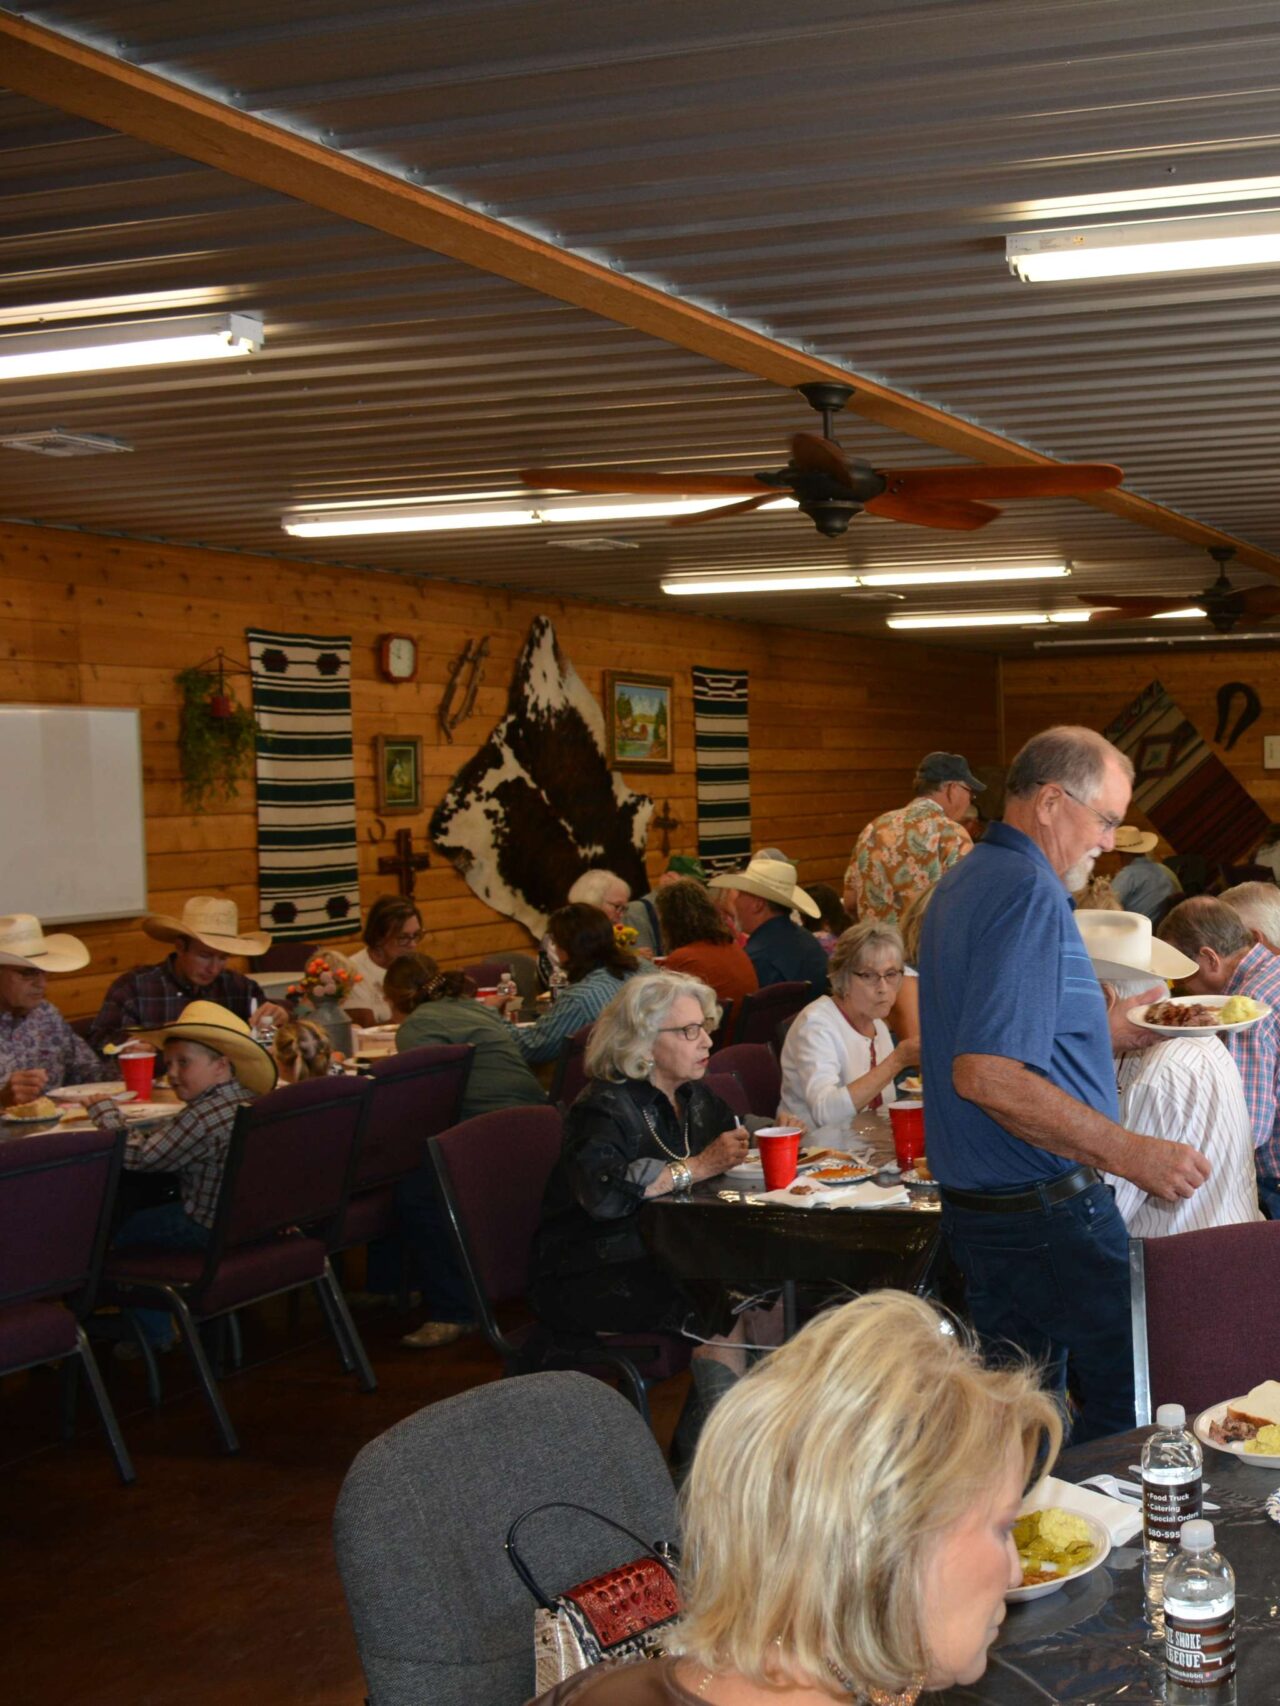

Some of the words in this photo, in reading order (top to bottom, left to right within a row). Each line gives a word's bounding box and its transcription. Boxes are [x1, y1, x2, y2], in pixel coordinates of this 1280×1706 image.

[1149, 1493, 1167, 1501] Food
[1169, 1493, 1190, 1501] Truck
[1149, 1503, 1181, 1513] Catering
[1149, 1513, 1175, 1522] Special
[1177, 1511, 1199, 1522] Orders
[1175, 1631, 1201, 1650] SMOKE
